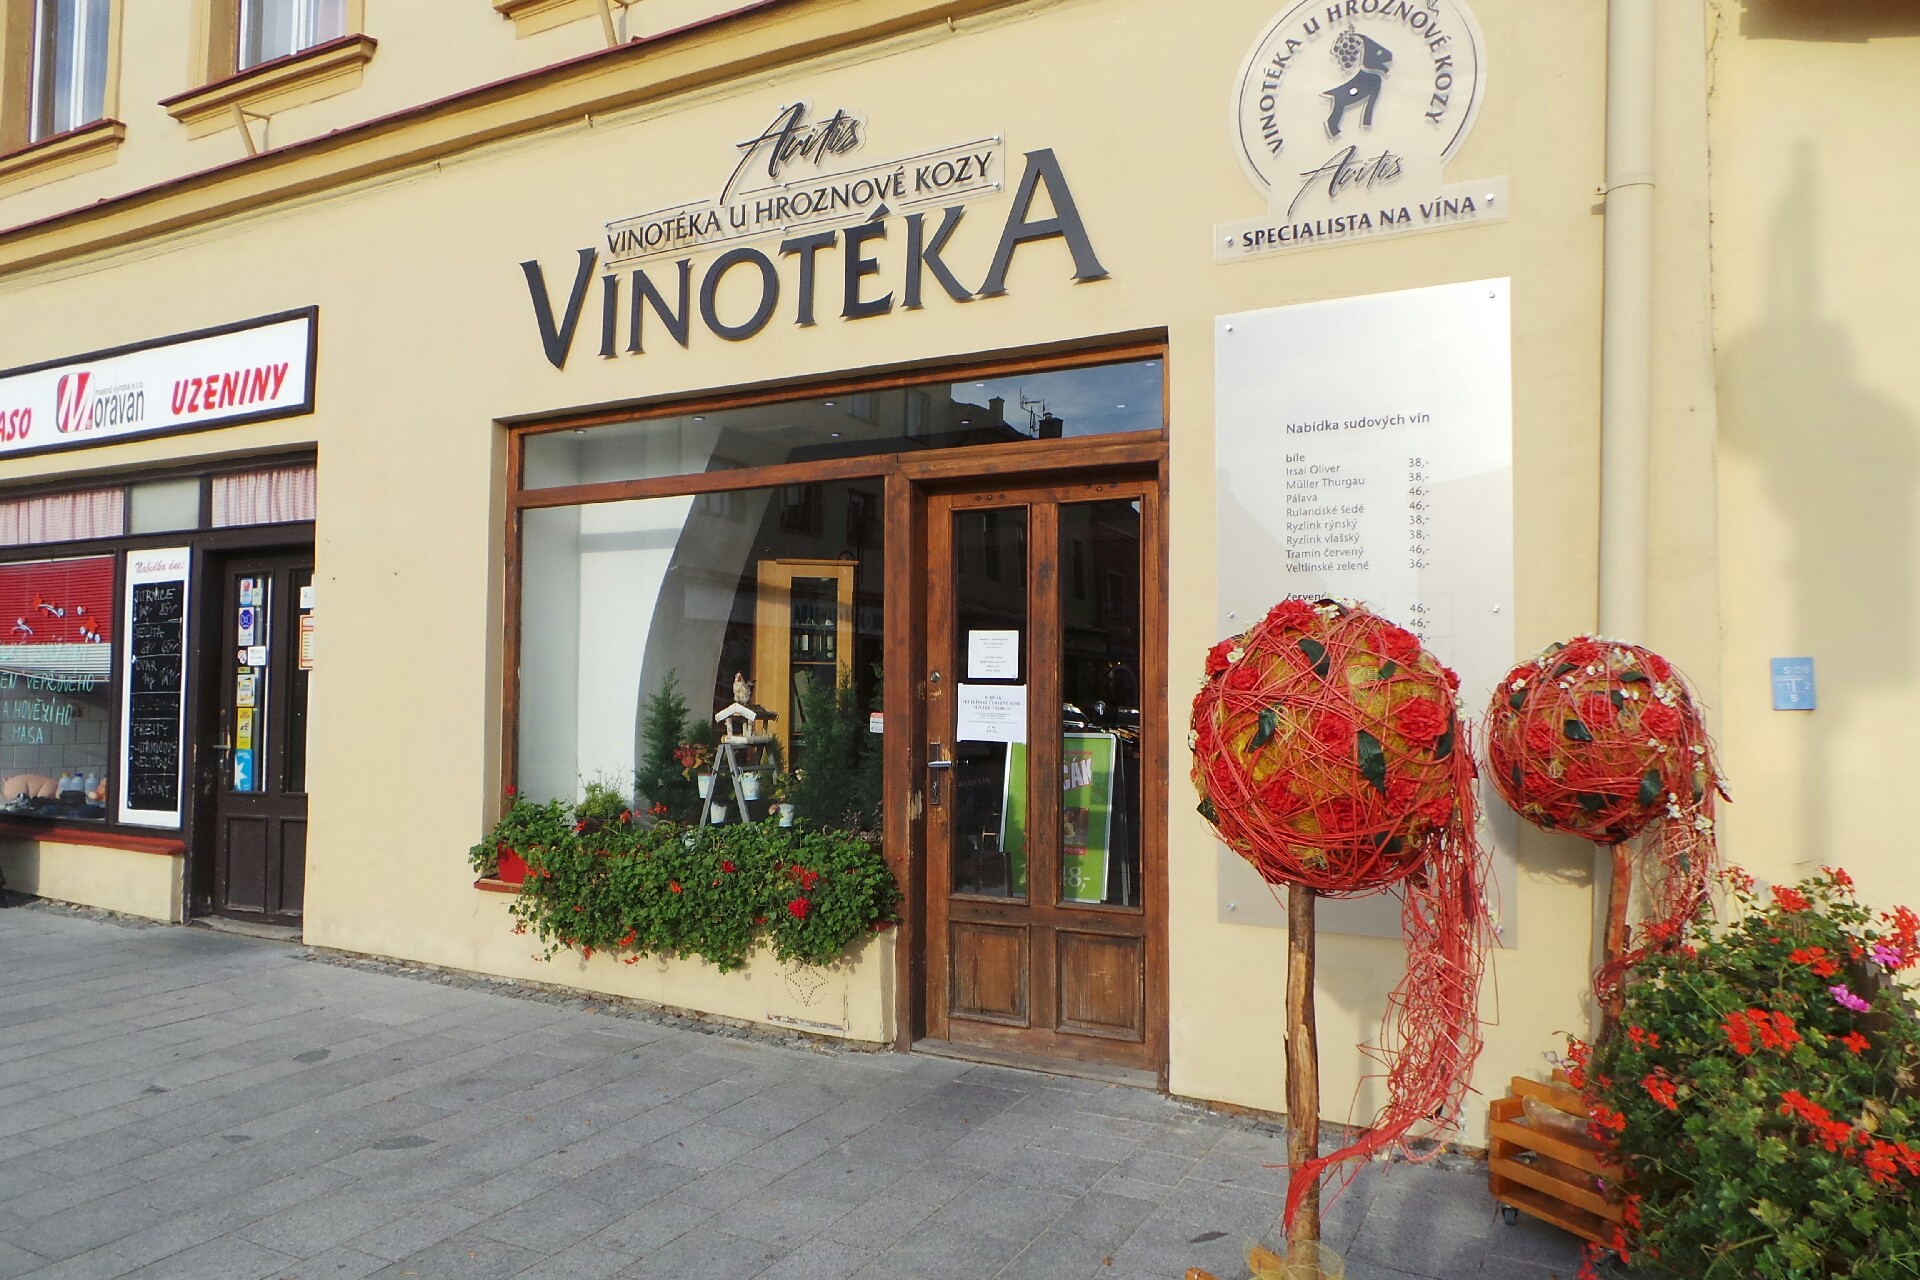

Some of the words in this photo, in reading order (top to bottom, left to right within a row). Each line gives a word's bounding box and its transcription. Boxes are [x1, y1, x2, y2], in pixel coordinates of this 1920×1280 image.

[1259, 37, 1303, 154] VINOTÉKA
[1325, 0, 1453, 54] HROZNOVÉ
[1424, 54, 1453, 124] KOZY
[607, 210, 721, 255] VINOTÉKA
[729, 203, 747, 229] U
[754, 165, 907, 226] HROZNOVÉ
[913, 150, 993, 193] KOZY
[1242, 213, 1372, 247] SPECIALISTA
[1379, 206, 1412, 227] NA
[1419, 196, 1476, 218] VÍNA
[519, 147, 1110, 371] VINOTÉKA
[171, 361, 289, 416] UZENINY
[1286, 420, 1339, 434] Nabídka
[1343, 413, 1405, 430] sudových
[1409, 412, 1430, 425] vín
[1286, 453, 1306, 463] bíle
[1286, 466, 1307, 476] Irsai
[1309, 464, 1341, 475] Oliver
[1408, 457, 1430, 468] 38,-
[1286, 479, 1319, 490] Müller
[1321, 477, 1365, 488] Thurgau
[1408, 472, 1430, 483] 38,-
[1286, 493, 1318, 504] Pálava
[1408, 486, 1430, 497] 46,-
[1286, 505, 1338, 517] Rulandské
[1340, 503, 1365, 514] šedé
[1408, 501, 1430, 511] 46,-
[1286, 521, 1321, 534] Ryzlink
[1324, 518, 1358, 530] rýnský
[1408, 515, 1430, 526] 38,-
[1286, 535, 1321, 548] Ryzlink
[1324, 532, 1360, 544] vlašský
[1408, 529, 1430, 540] 38,-
[1286, 549, 1321, 559] Tramín
[1323, 546, 1364, 558] červený
[1408, 544, 1430, 555] 46,-
[1286, 562, 1334, 573] Veltlínské
[1336, 560, 1369, 571] zelené
[1408, 558, 1430, 569] 36,-
[1409, 603, 1431, 614] 46,-
[1409, 618, 1431, 629] 46,-
[1064, 866, 1091, 893] 8,-
